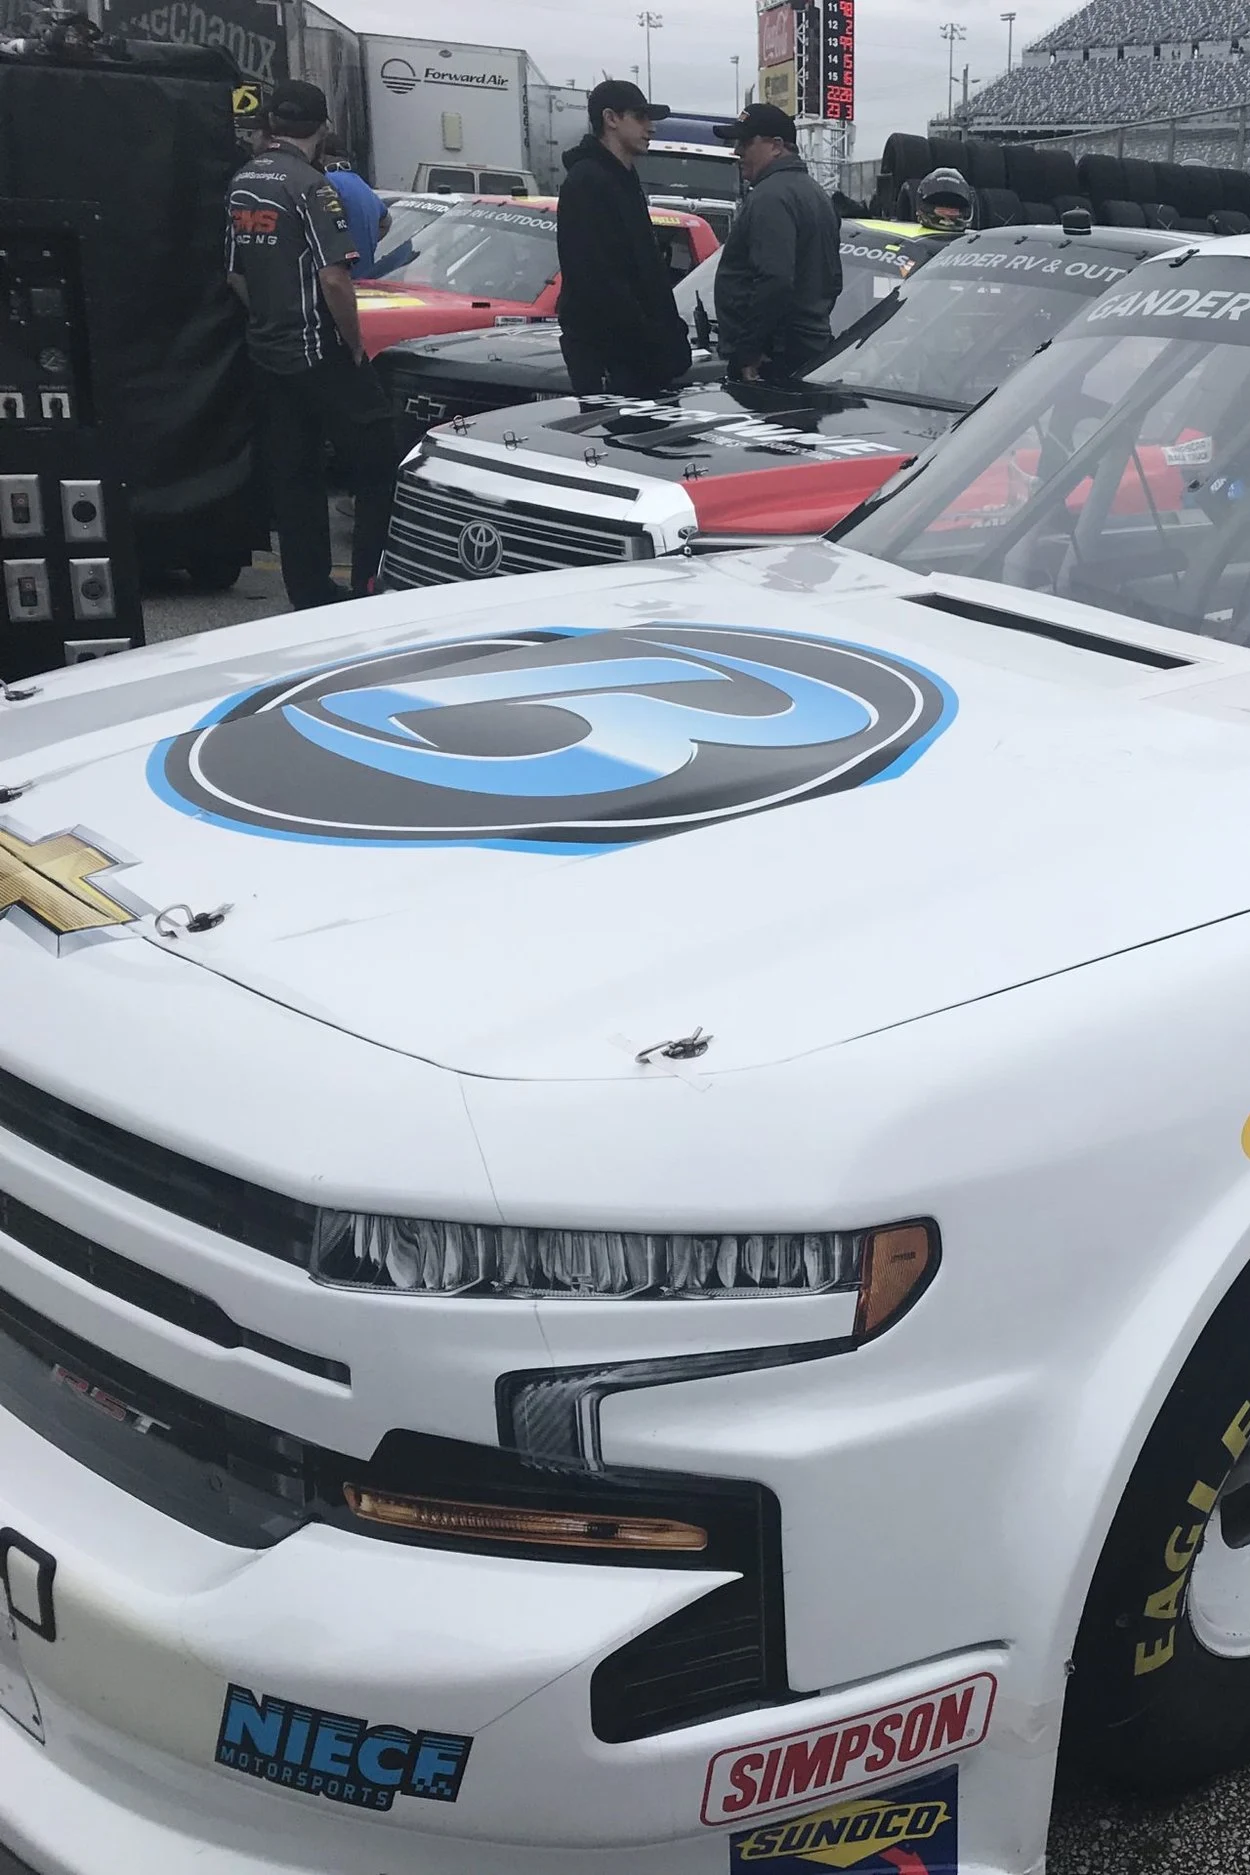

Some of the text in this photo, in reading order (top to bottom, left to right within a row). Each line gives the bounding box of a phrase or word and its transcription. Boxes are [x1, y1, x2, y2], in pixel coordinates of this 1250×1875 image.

[424, 67, 509, 87] Forward Air
[839, 242, 910, 266] DOORS
[1004, 255, 1044, 271] RV
[1042, 259, 1063, 273] &
[223, 1687, 472, 1796] NIECE
[722, 1686, 976, 1813] SIMPSON
[220, 1744, 391, 1808] MOTORSPORTS
[747, 1805, 941, 1851] SUNOCO
